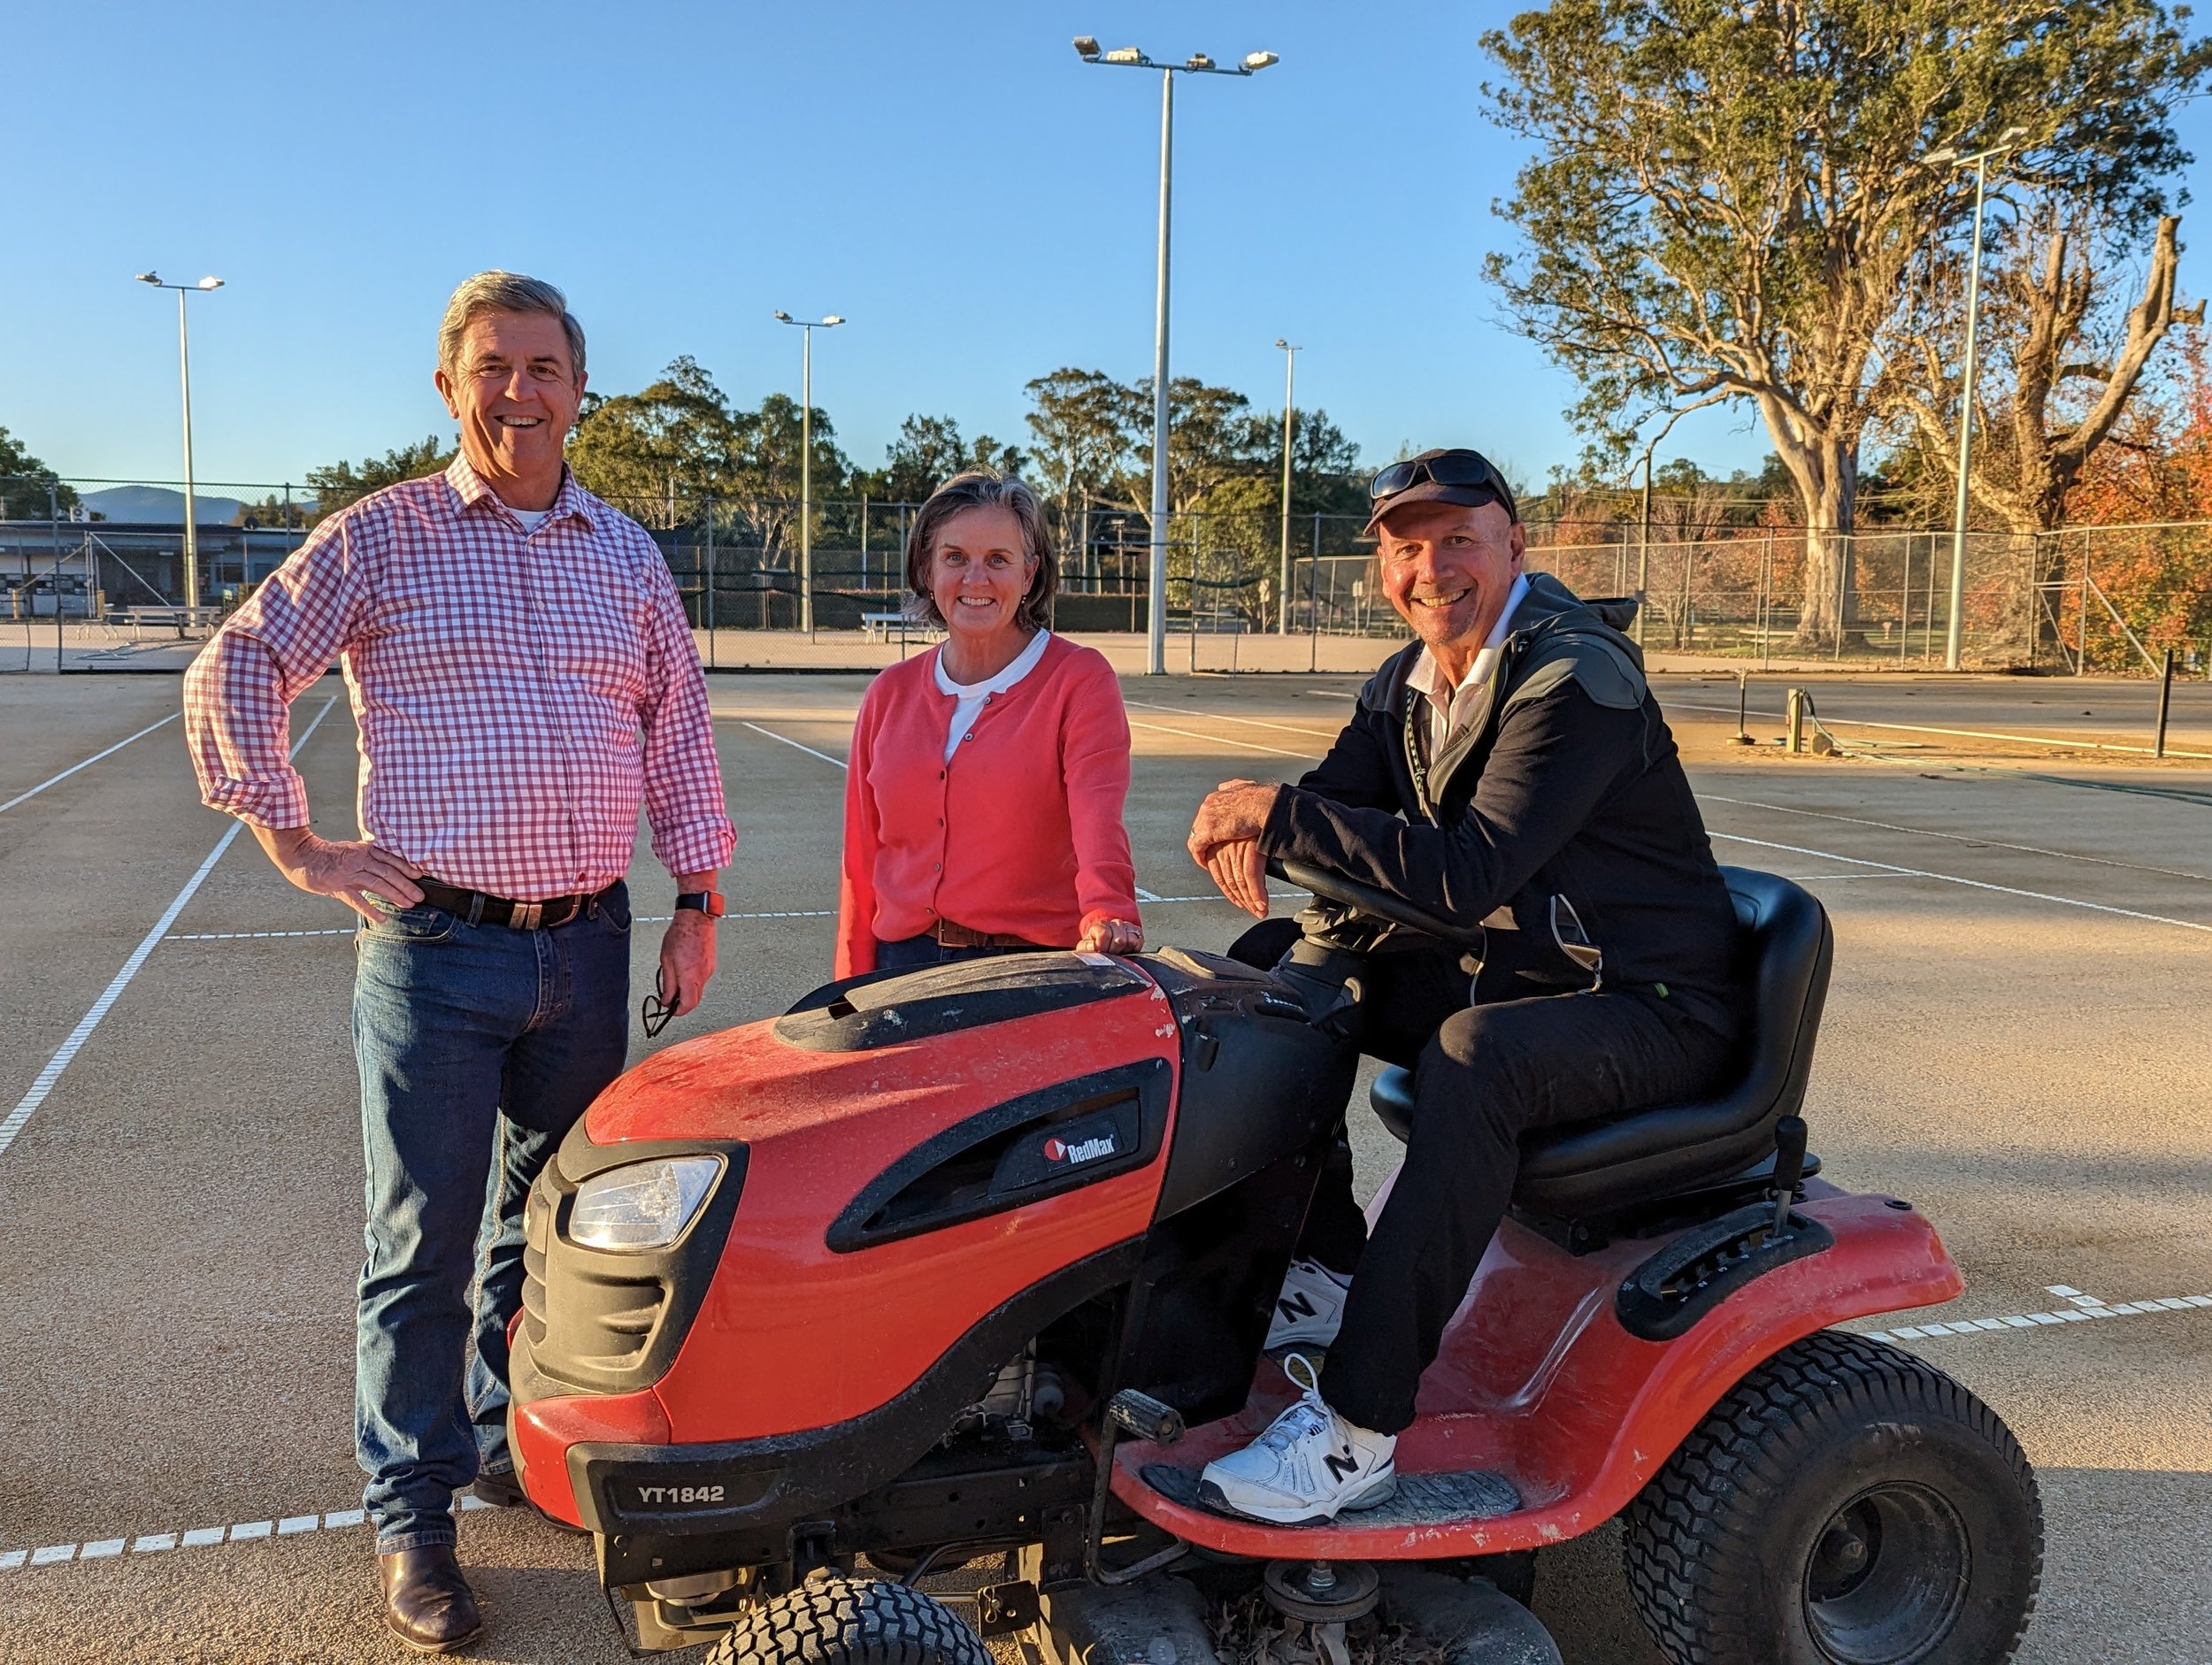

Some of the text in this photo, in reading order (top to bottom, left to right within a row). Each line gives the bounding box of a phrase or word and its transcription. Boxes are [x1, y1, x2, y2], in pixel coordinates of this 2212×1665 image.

[1067, 1138, 1115, 1164] RedMax
[1279, 1291, 1317, 1324] N
[1323, 1445, 1360, 1485] N
[638, 1485, 725, 1503] YT1842
